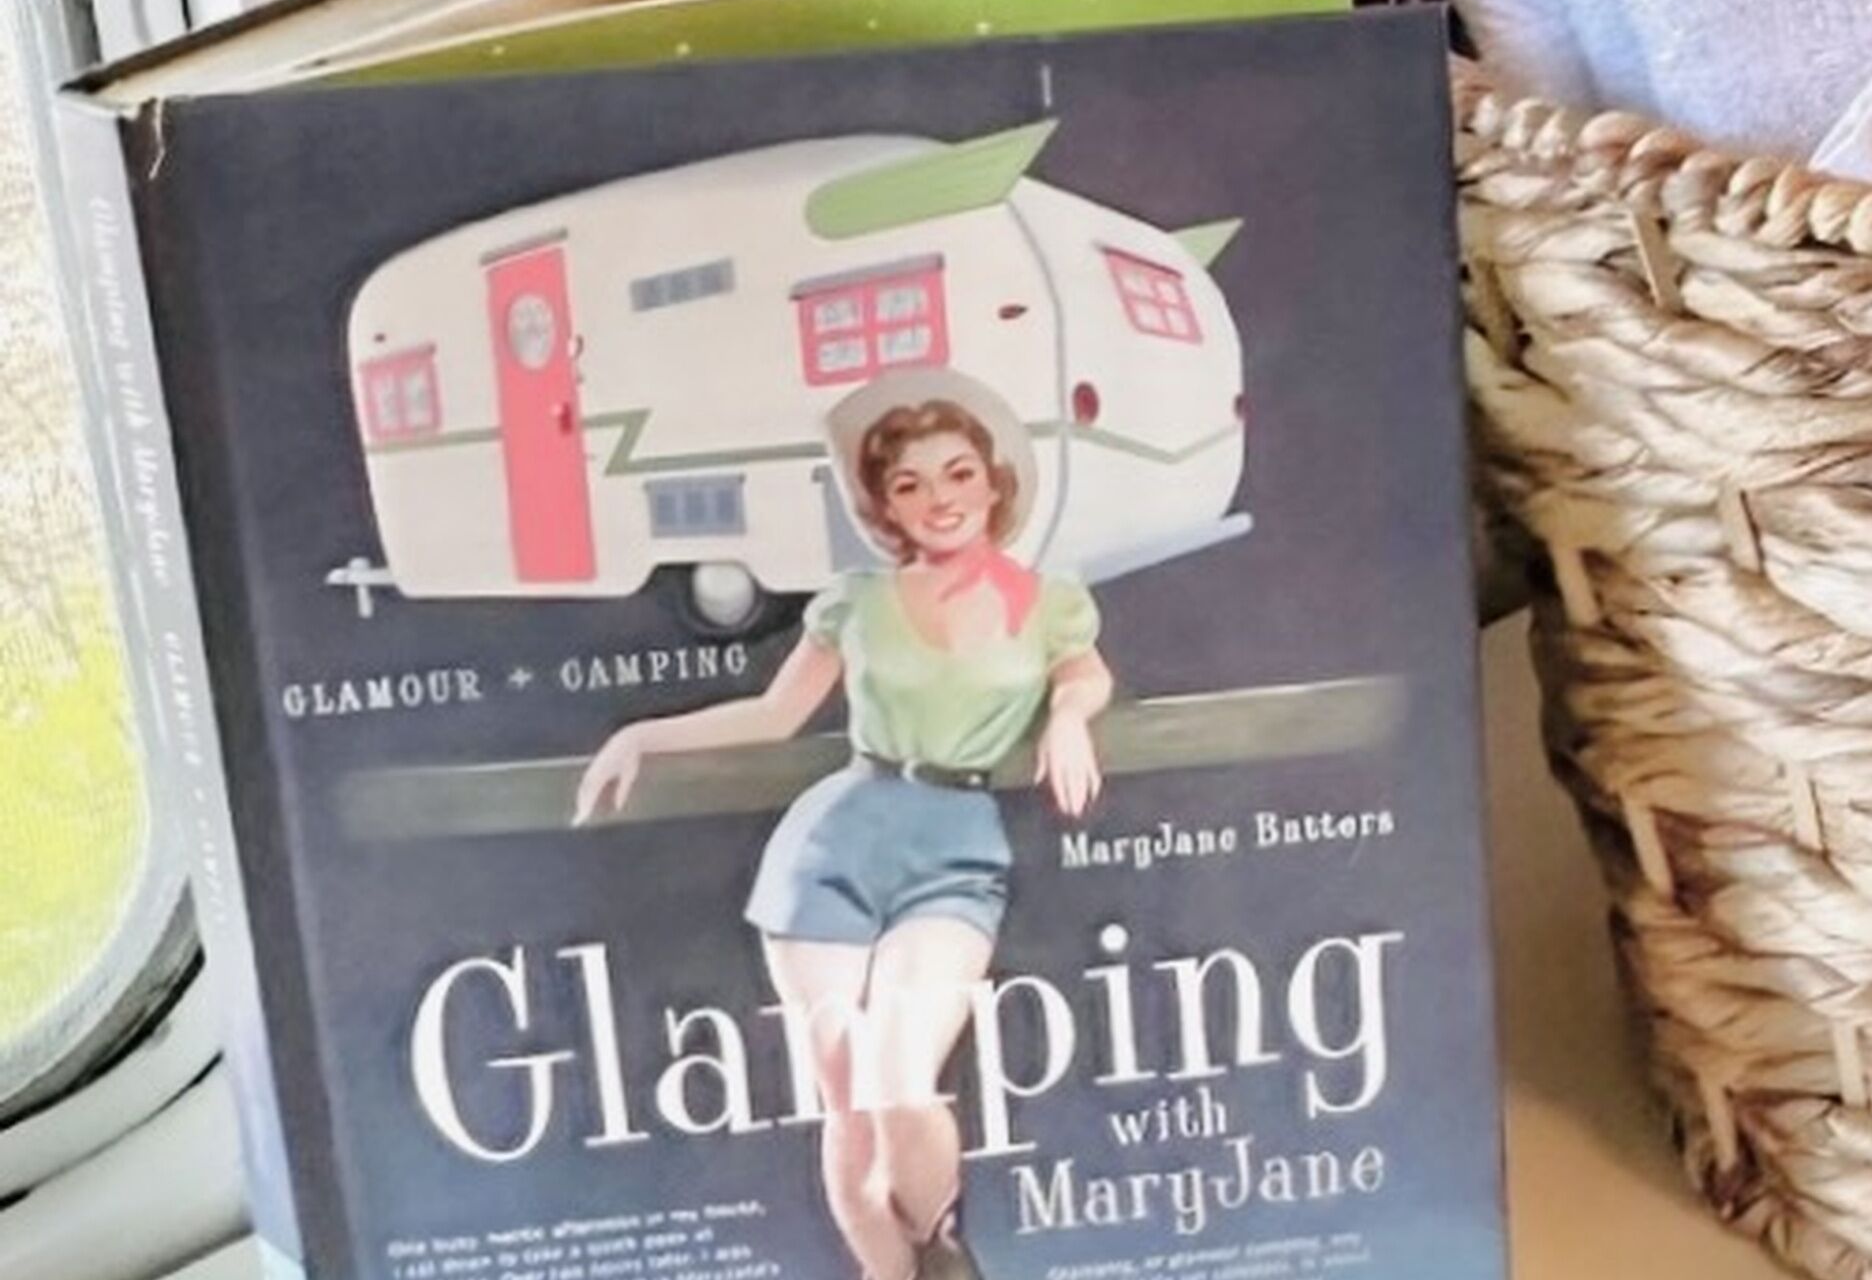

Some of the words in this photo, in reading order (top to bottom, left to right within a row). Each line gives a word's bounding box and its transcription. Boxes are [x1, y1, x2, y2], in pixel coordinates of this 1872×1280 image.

[283, 668, 483, 717] GLAMOUR
[560, 643, 748, 692] CAMPING
[1060, 822, 1237, 870] MaryJane
[1255, 809, 1395, 847] Butters
[409, 925, 1405, 1164] Glamping
[1111, 1087, 1226, 1147] with
[1011, 1133, 1384, 1235] MaryJane
